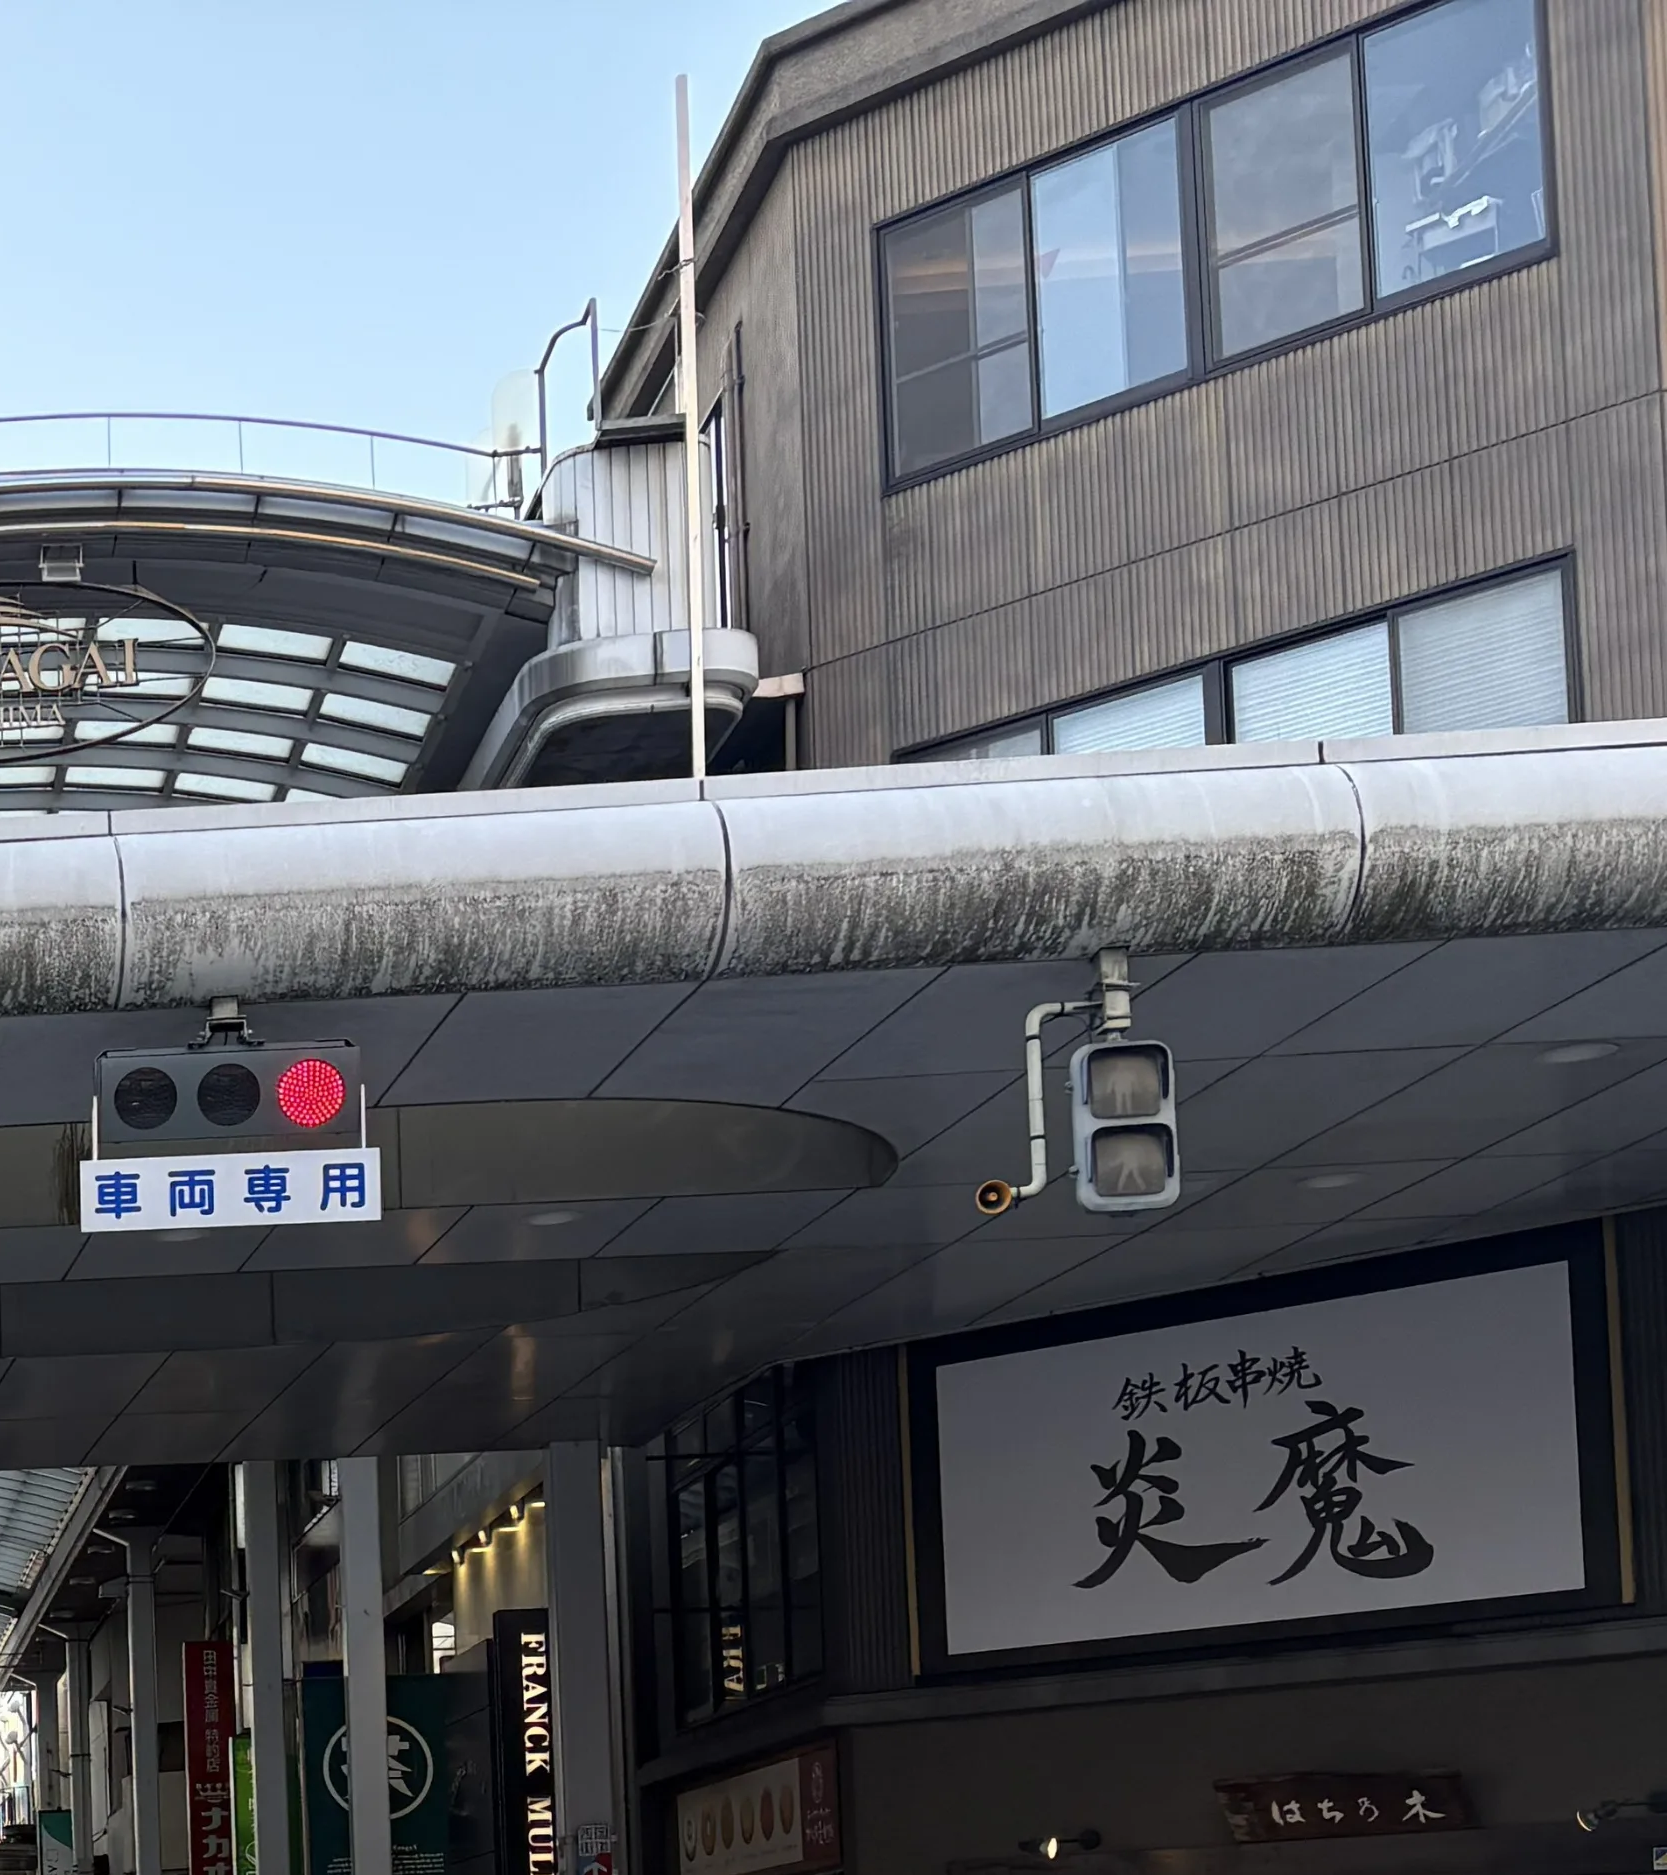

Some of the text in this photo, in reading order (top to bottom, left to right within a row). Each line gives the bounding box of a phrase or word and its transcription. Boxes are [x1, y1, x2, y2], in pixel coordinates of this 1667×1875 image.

[94, 1163, 366, 1220] 車両専用
[1071, 1400, 1435, 1590] 炎魔
[520, 1631, 550, 1776] FRANCK
